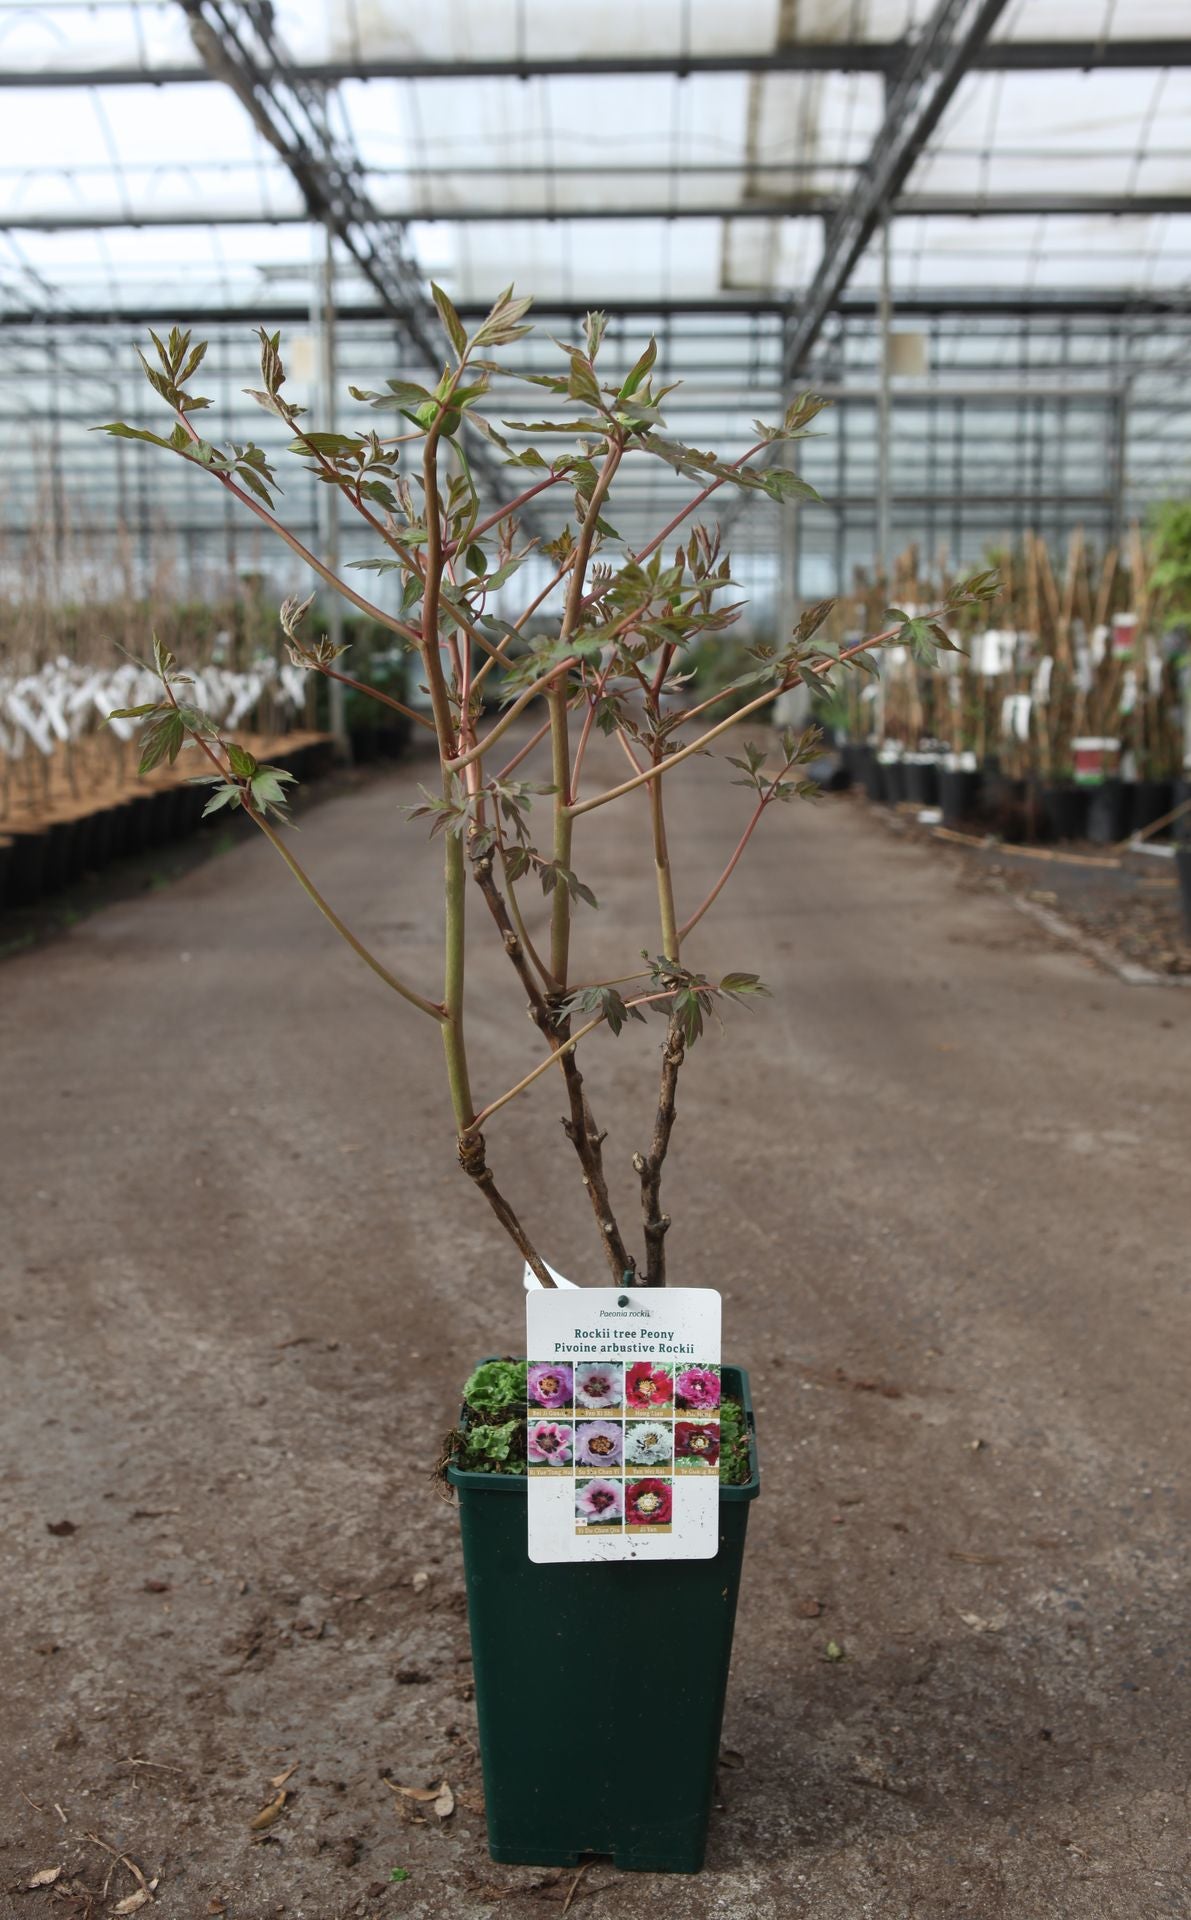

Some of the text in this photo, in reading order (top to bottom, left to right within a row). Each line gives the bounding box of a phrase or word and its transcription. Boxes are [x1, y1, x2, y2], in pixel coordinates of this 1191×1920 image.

[599, 1309, 651, 1317] Paeonia rockii
[574, 1328, 675, 1341] Rockii tree Peony
[554, 1342, 695, 1354] Pivoine arbustive Rockii
